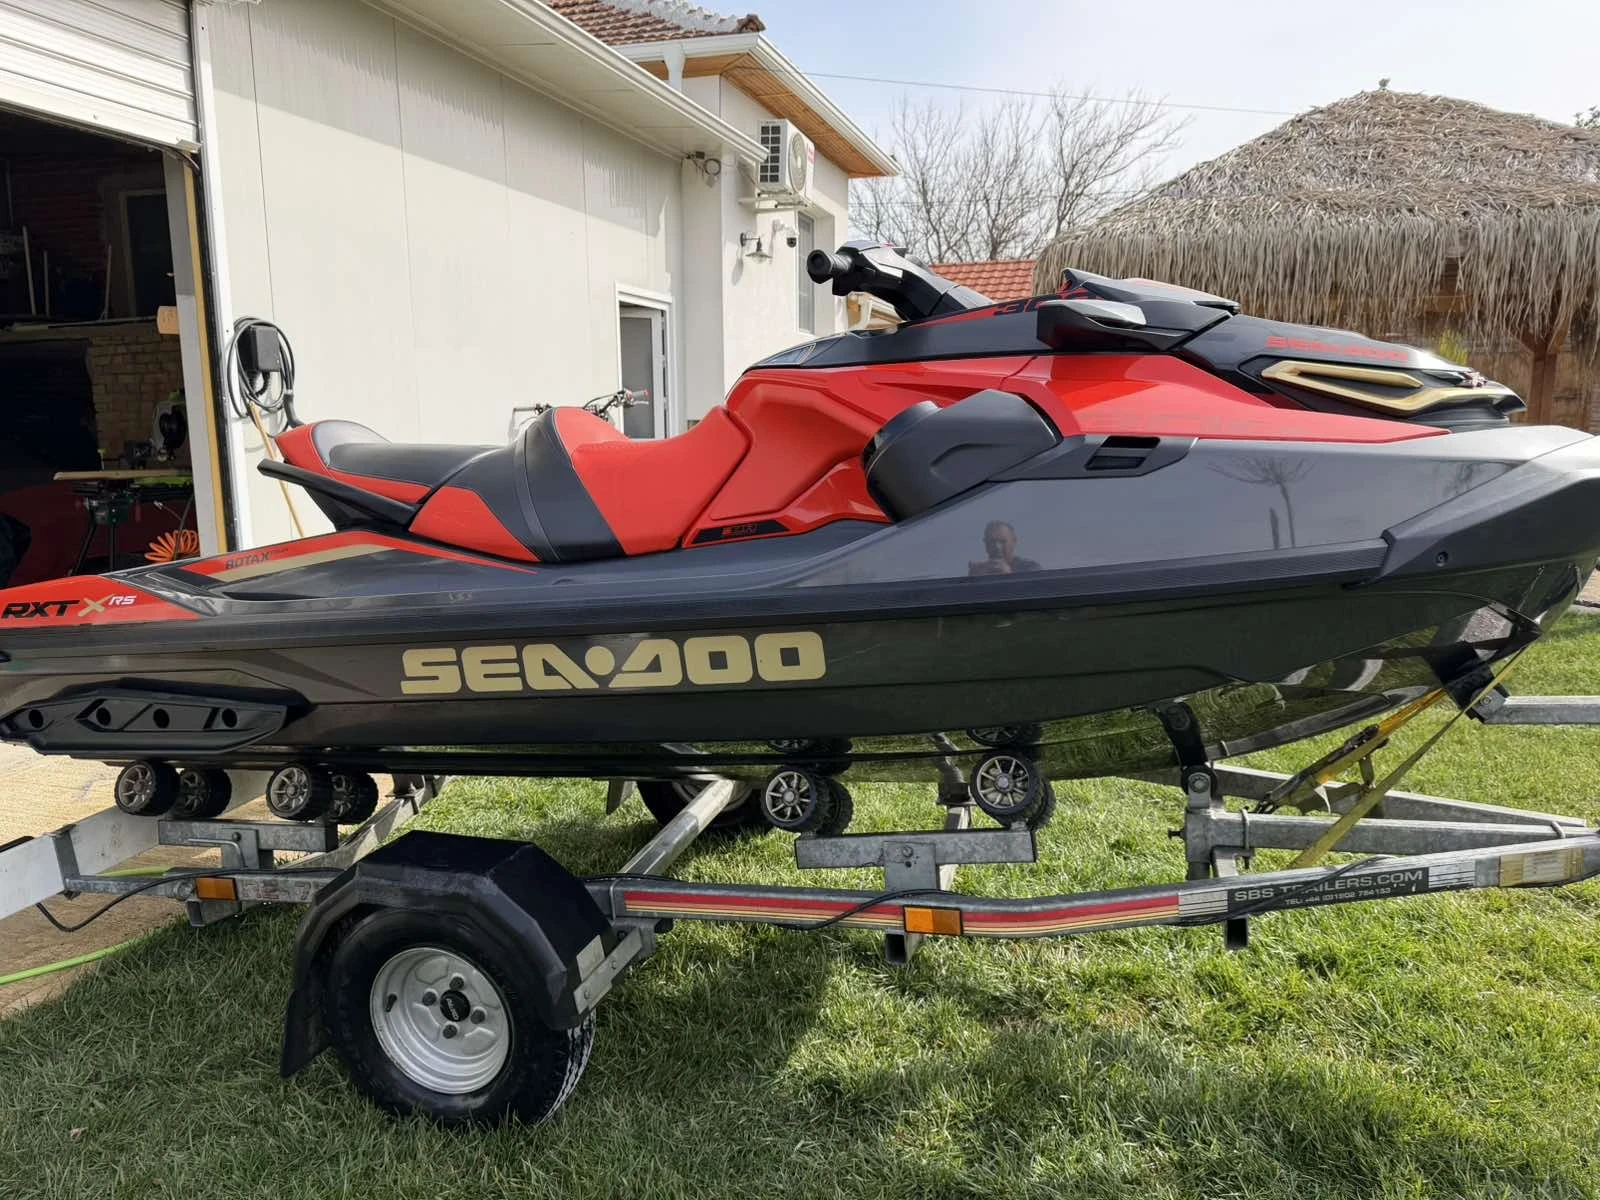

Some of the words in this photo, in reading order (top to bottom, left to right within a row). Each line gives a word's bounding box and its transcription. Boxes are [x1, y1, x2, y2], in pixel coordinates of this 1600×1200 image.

[1, 600, 80, 618] RXT
[78, 594, 116, 617] X
[1234, 887, 1275, 902] SBS
